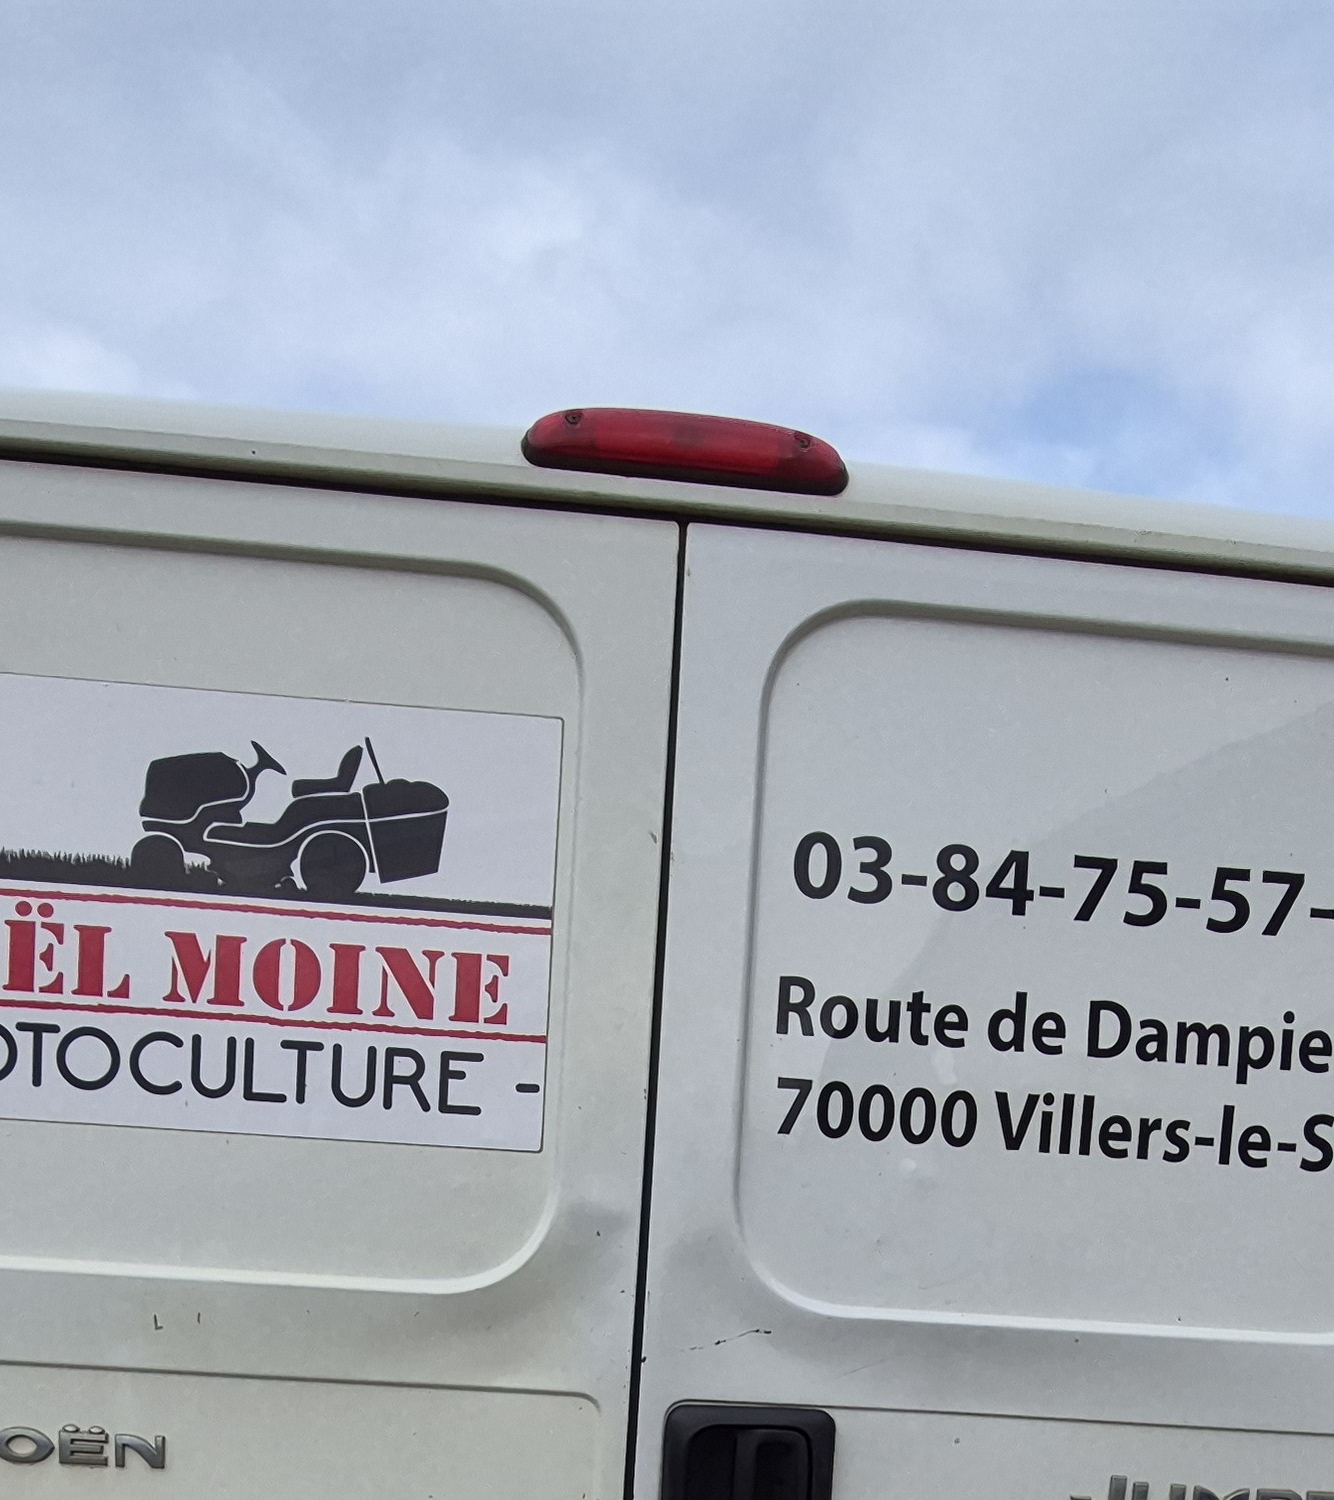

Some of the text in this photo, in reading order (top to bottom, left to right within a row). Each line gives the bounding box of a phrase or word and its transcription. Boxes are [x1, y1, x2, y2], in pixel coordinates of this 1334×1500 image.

[162, 930, 510, 1026] MOINE
[776, 975, 969, 1048] Route
[987, 991, 1066, 1055] de
[776, 1076, 978, 1148] 70000
